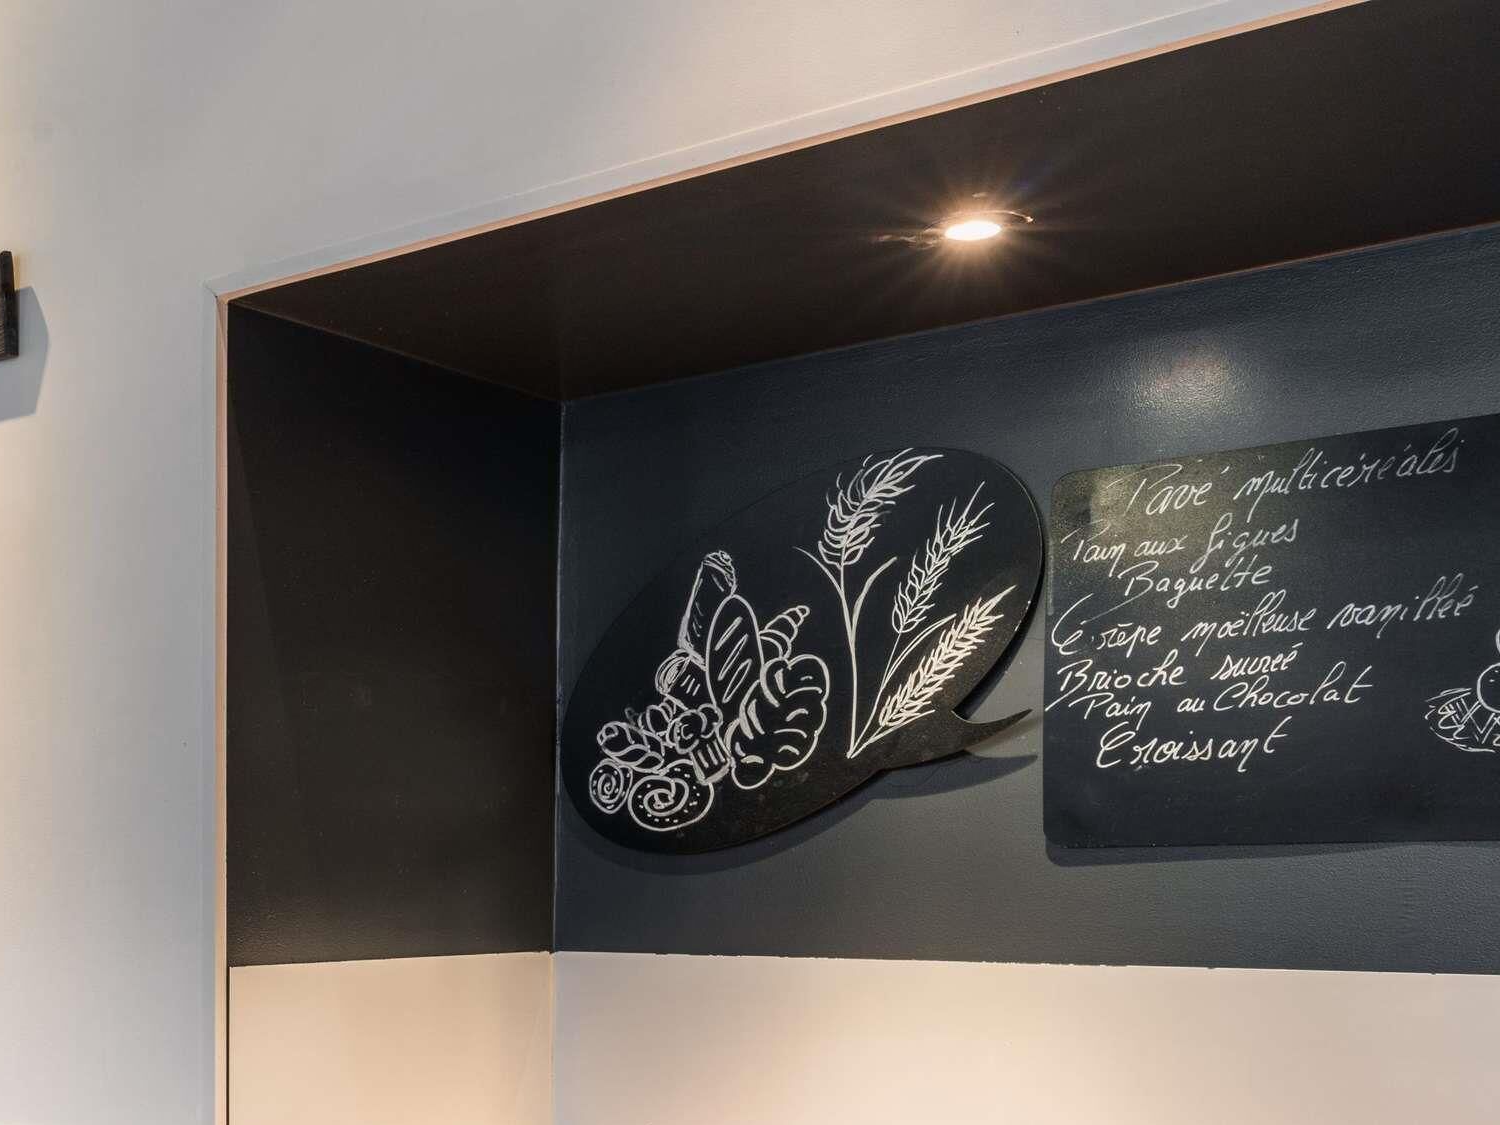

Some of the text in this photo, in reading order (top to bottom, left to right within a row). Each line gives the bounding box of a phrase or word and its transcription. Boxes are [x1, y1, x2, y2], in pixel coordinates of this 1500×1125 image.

[1060, 511, 1299, 578] Pain aux figues
[1116, 556, 1273, 608] Baguette
[1050, 649, 1187, 692] Brioche
[1068, 660, 1374, 731] Pain au Chocolat
[1096, 717, 1293, 773] Croissant
